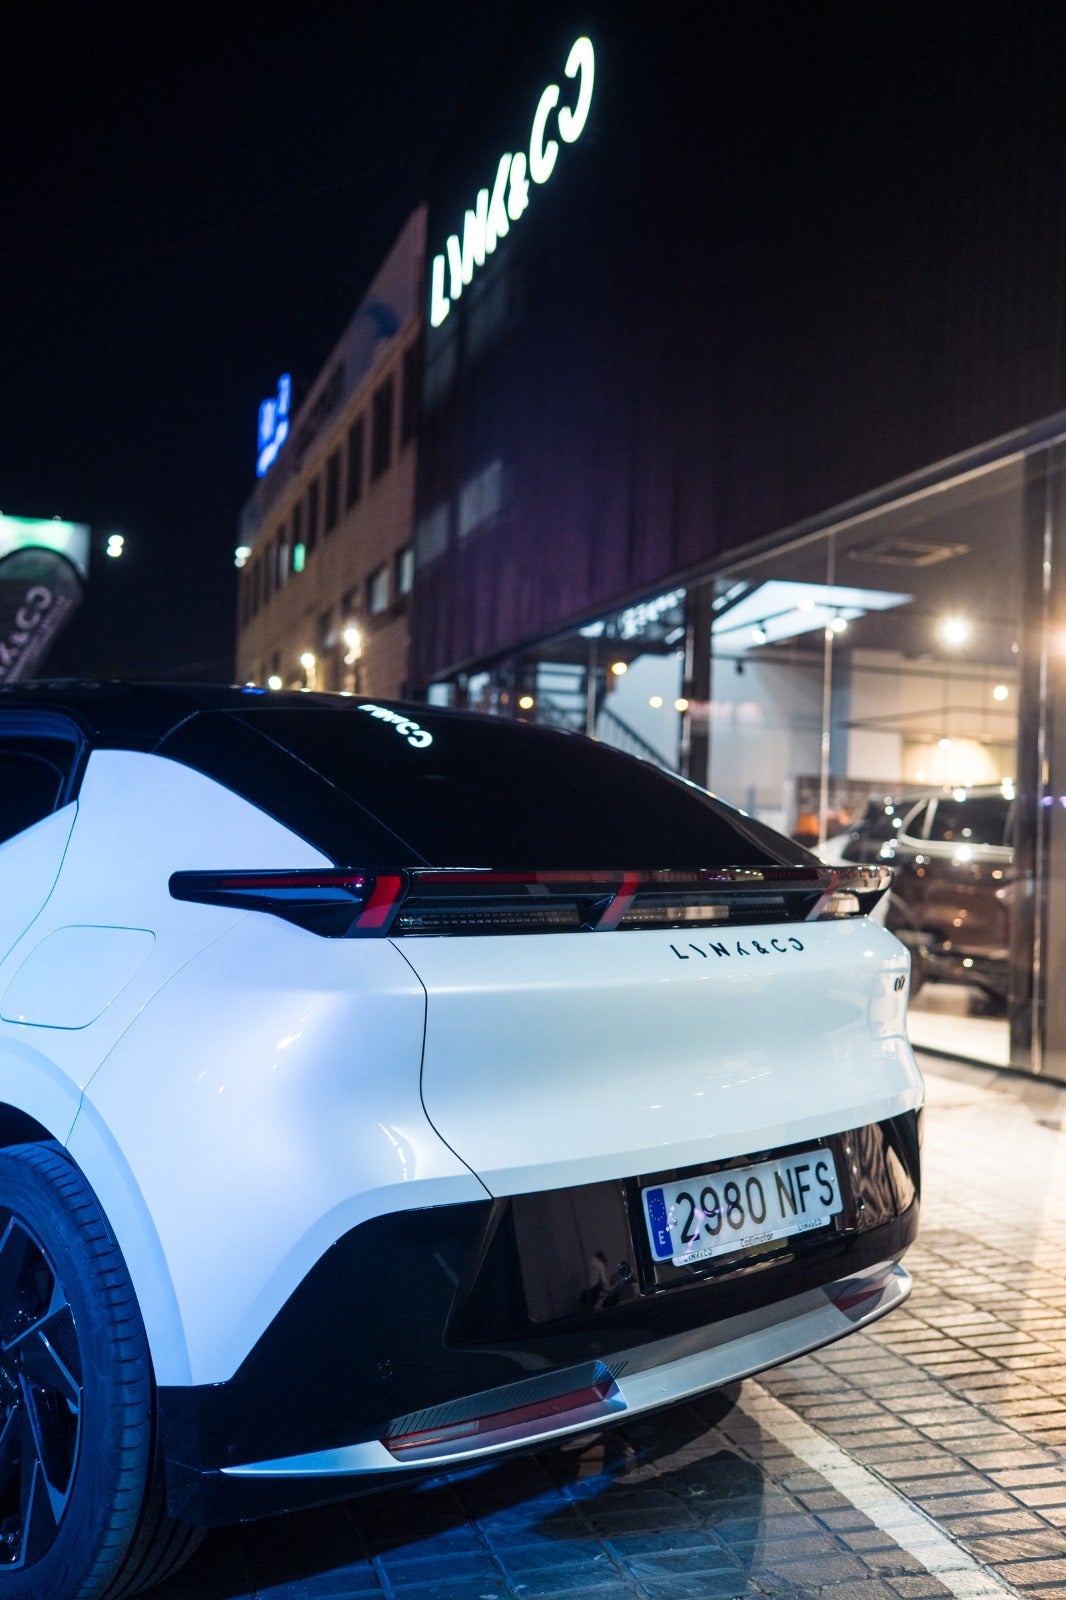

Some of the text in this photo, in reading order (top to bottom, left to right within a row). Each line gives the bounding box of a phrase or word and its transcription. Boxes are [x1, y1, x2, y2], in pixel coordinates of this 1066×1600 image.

[675, 1161, 834, 1244] 2980 NFS
[657, 1230, 666, 1245] E
